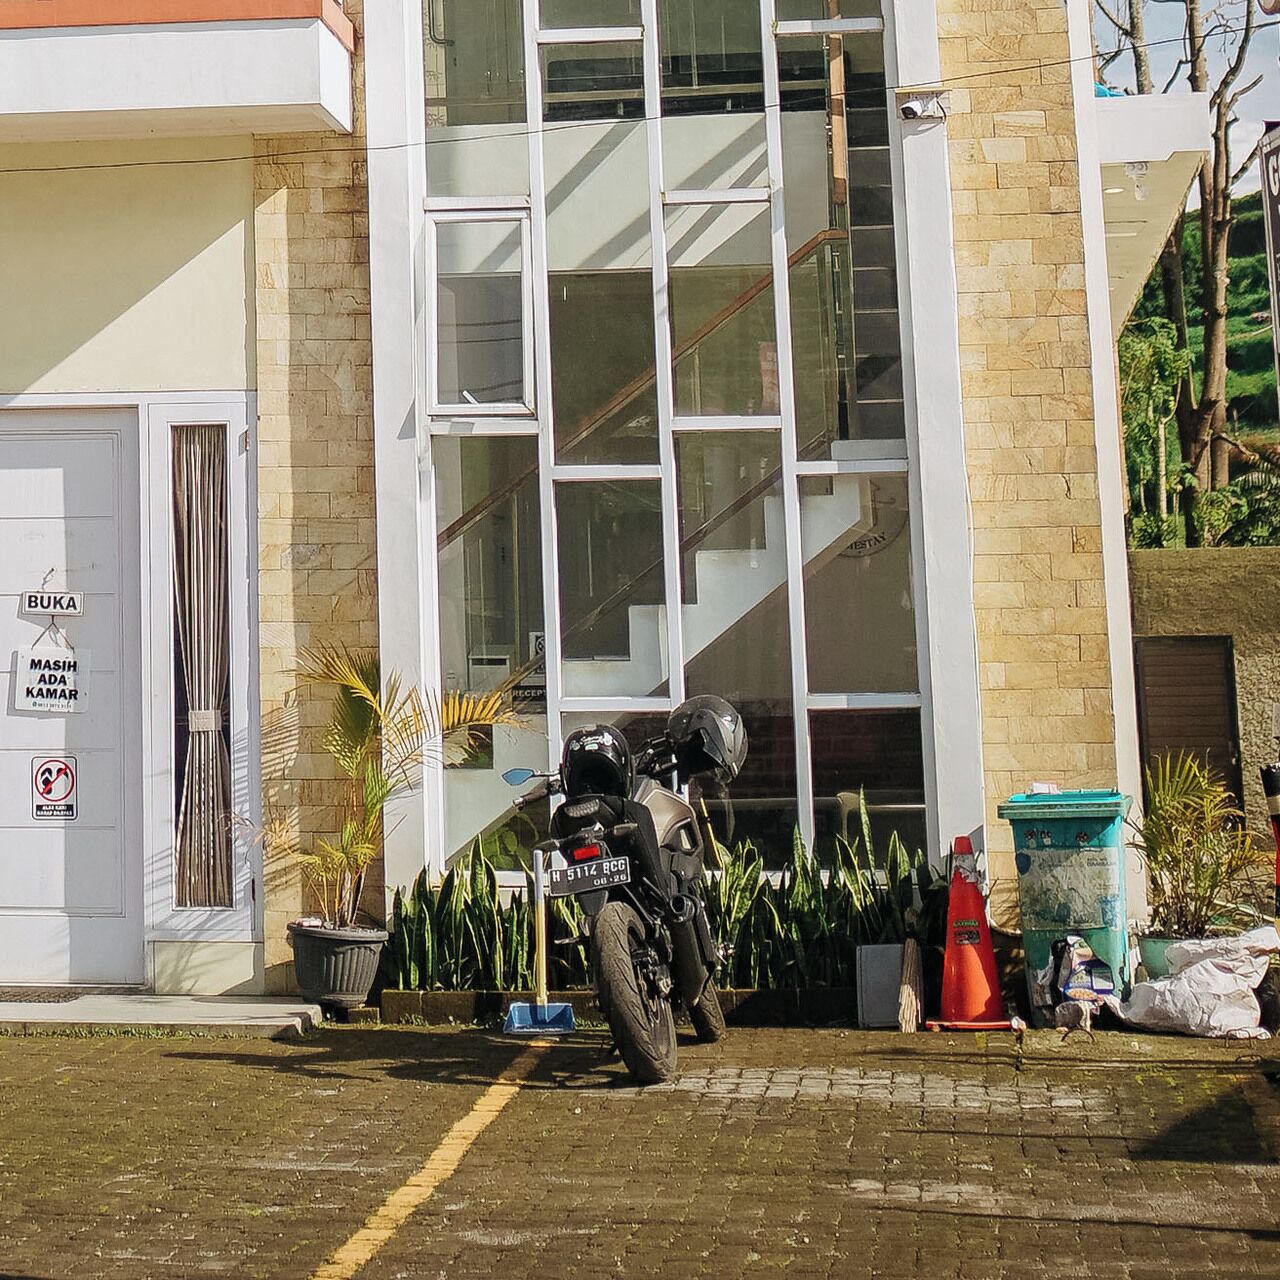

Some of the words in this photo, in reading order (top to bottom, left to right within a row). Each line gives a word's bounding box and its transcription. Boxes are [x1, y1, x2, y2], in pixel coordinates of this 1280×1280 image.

[27, 595, 77, 610] BUKA
[30, 658, 77, 672] MASIH
[37, 674, 67, 686] ADA
[26, 687, 78, 701] KAMAR
[552, 871, 561, 882] H
[567, 864, 597, 881] 5114
